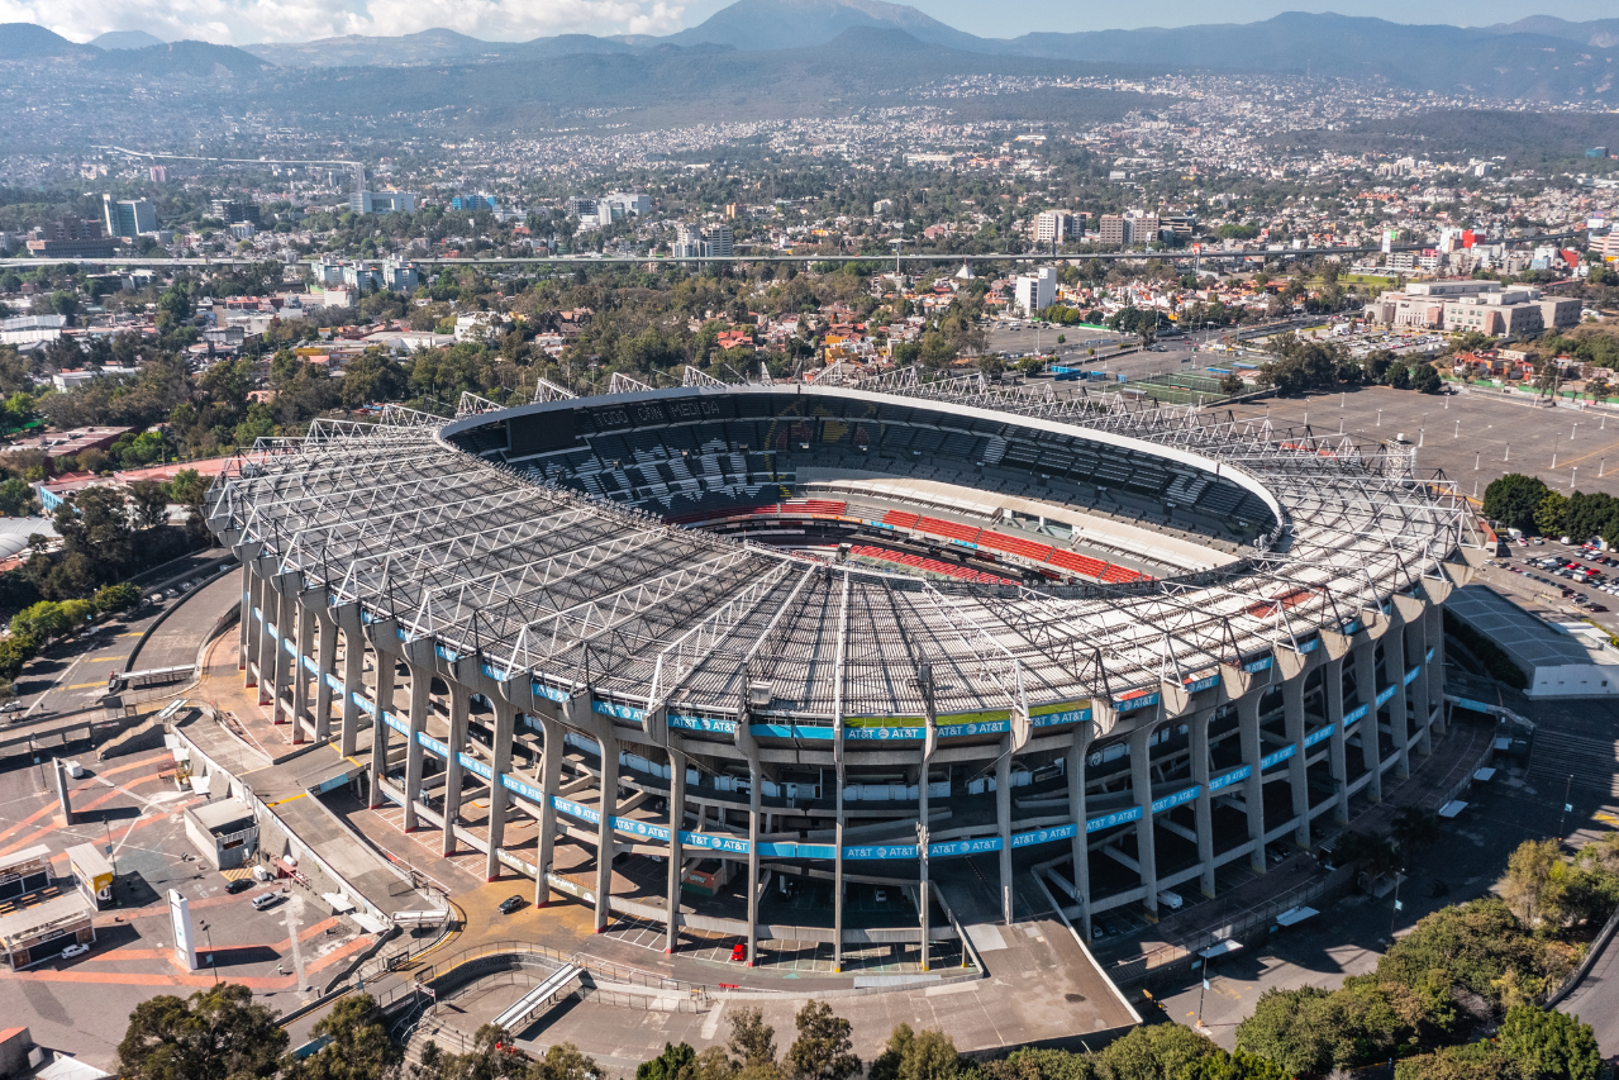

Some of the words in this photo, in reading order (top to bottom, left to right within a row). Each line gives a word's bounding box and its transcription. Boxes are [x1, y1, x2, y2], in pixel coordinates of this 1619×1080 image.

[1196, 678, 1214, 692] AT&T
[1133, 696, 1154, 708] AT&T
[673, 718, 698, 728] AT&T
[1061, 711, 1086, 722] AT&T
[848, 729, 874, 738] AT&T
[892, 728, 919, 738] AT&T
[938, 726, 963, 737] AT&T
[979, 722, 1005, 732] AT&T
[1232, 769, 1247, 781] AT&T
[1178, 789, 1195, 802] AT&T
[554, 799, 572, 812] AT&T
[1086, 818, 1106, 830] AT&T
[1117, 810, 1138, 822] AT&T
[614, 820, 635, 832] AT&T
[648, 827, 670, 838] AT&T
[685, 834, 709, 846] AT&T
[723, 840, 748, 852] AT&T
[1012, 834, 1036, 846] AT&T
[1049, 827, 1072, 839] AT&T
[847, 848, 873, 857] AT&T
[889, 847, 914, 856] AT&T
[932, 844, 957, 854] AT&T
[972, 840, 997, 850] AT&T
